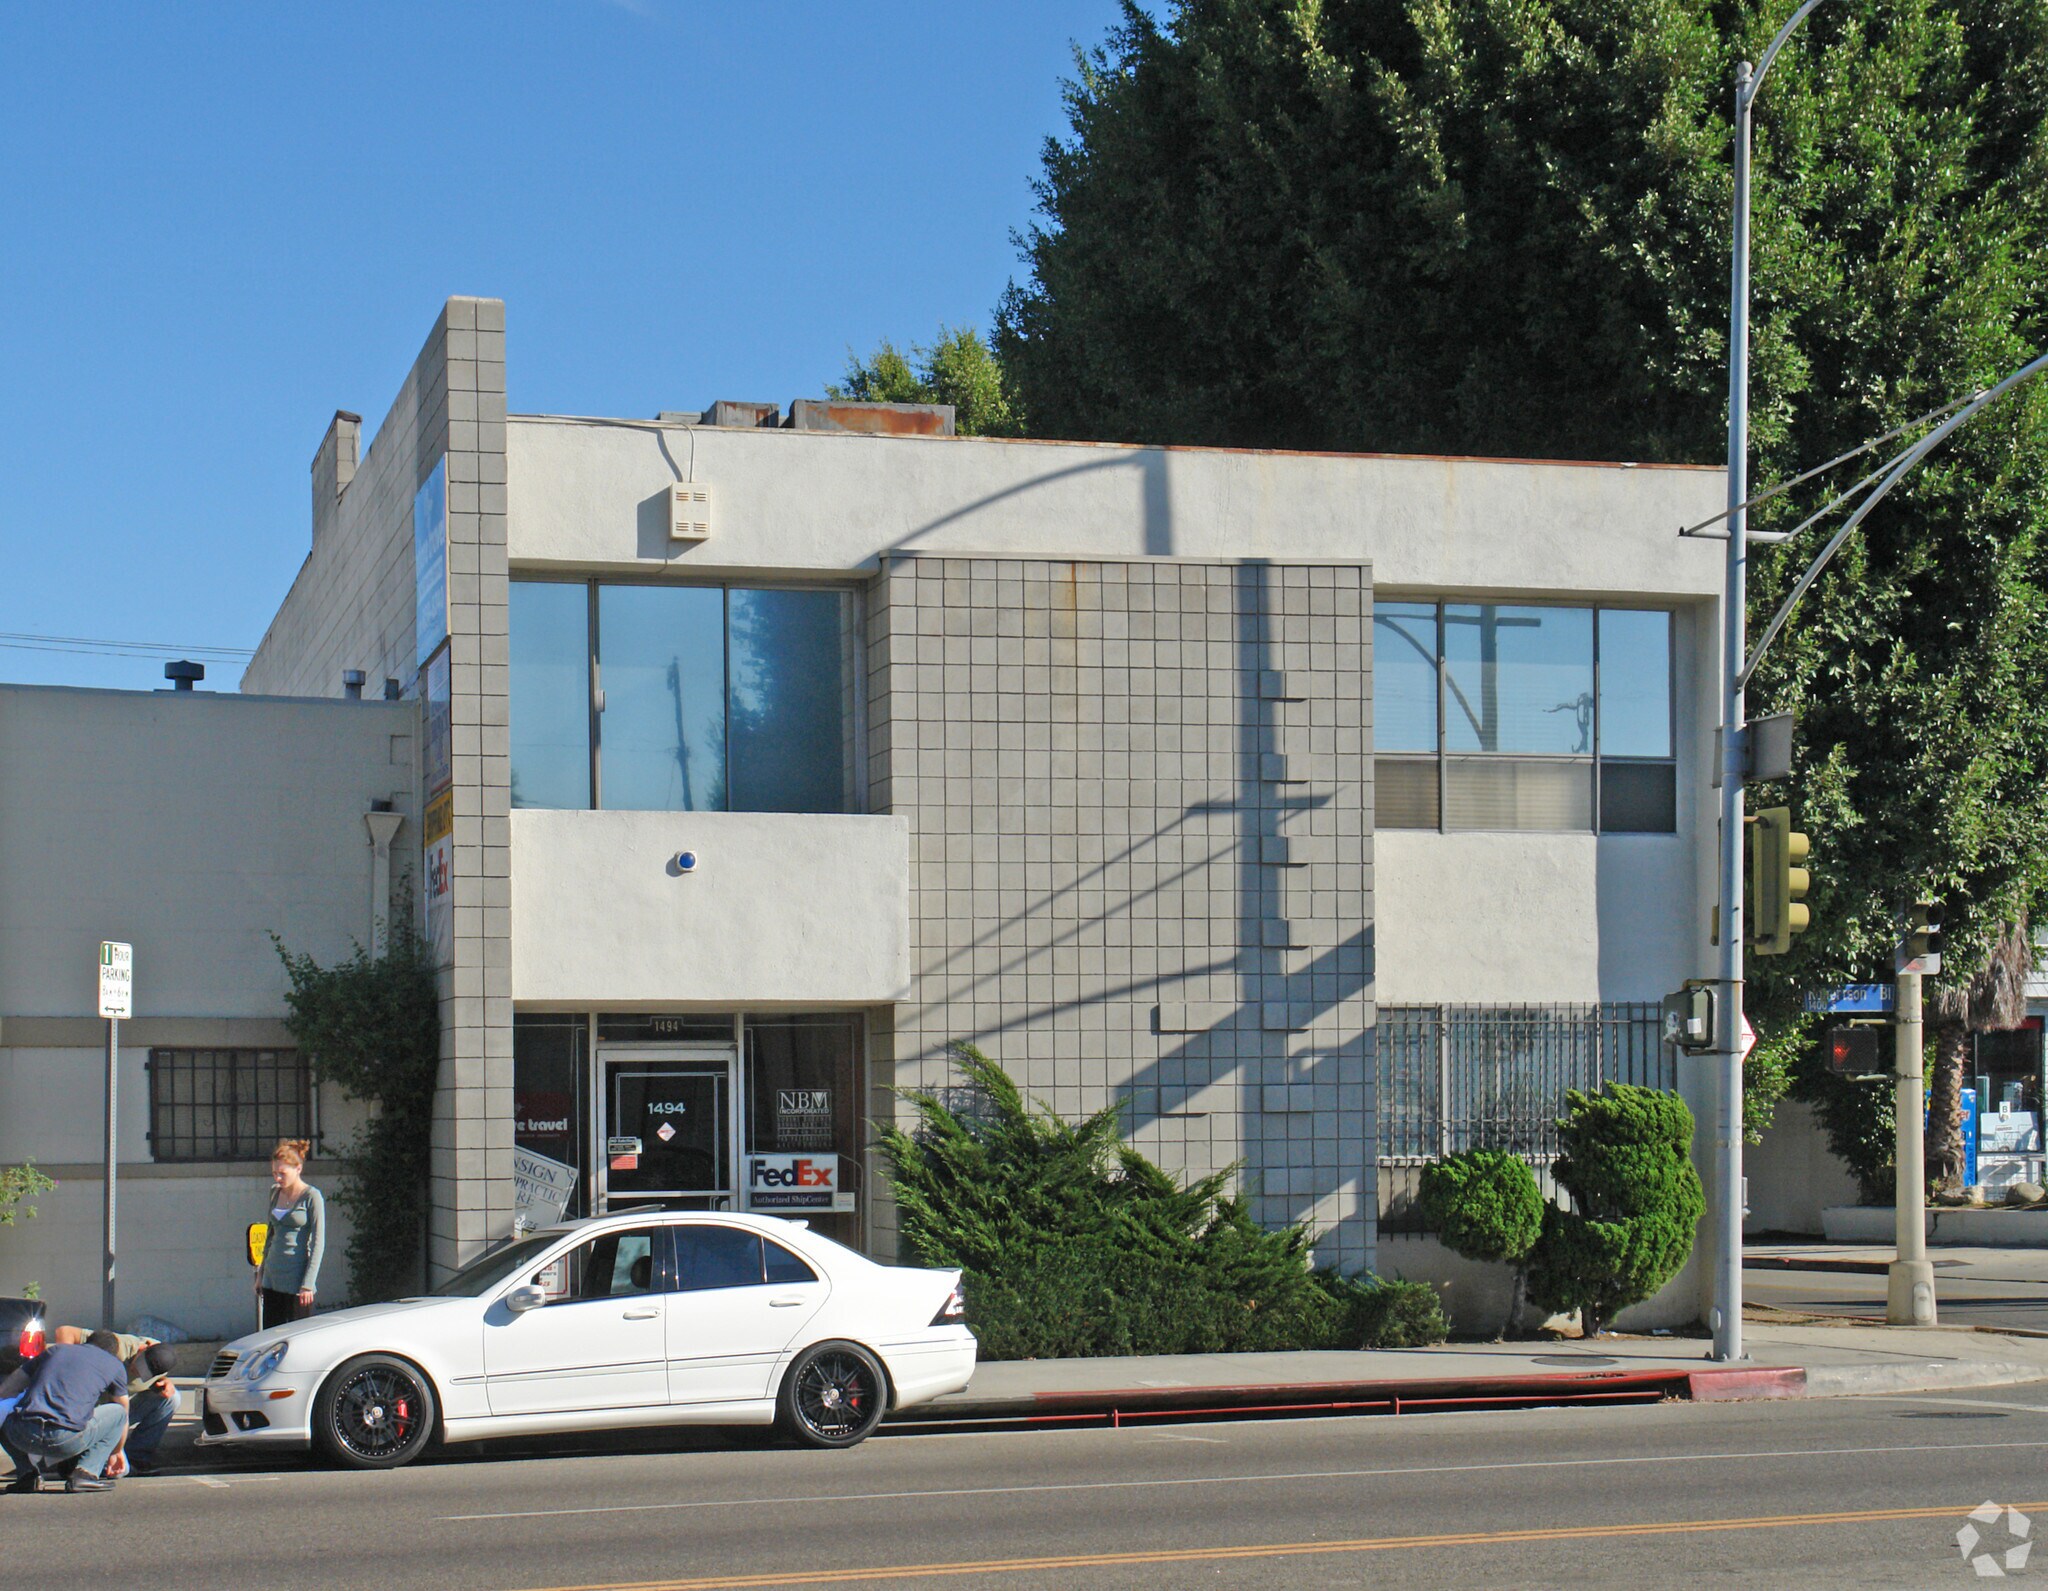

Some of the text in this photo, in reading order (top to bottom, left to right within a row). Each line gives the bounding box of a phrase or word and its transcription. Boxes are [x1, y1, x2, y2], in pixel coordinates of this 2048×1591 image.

[104, 944, 110, 964] 1
[102, 966, 130, 982] PARKING
[655, 1020, 678, 1032] 1494
[780, 1091, 828, 1109] NBM
[647, 1102, 685, 1114] 1494
[528, 1118, 568, 1131] travel
[750, 1159, 833, 1187] FedEx
[754, 1195, 790, 1204] Authorized
[791, 1195, 830, 1205] ShipCenter
